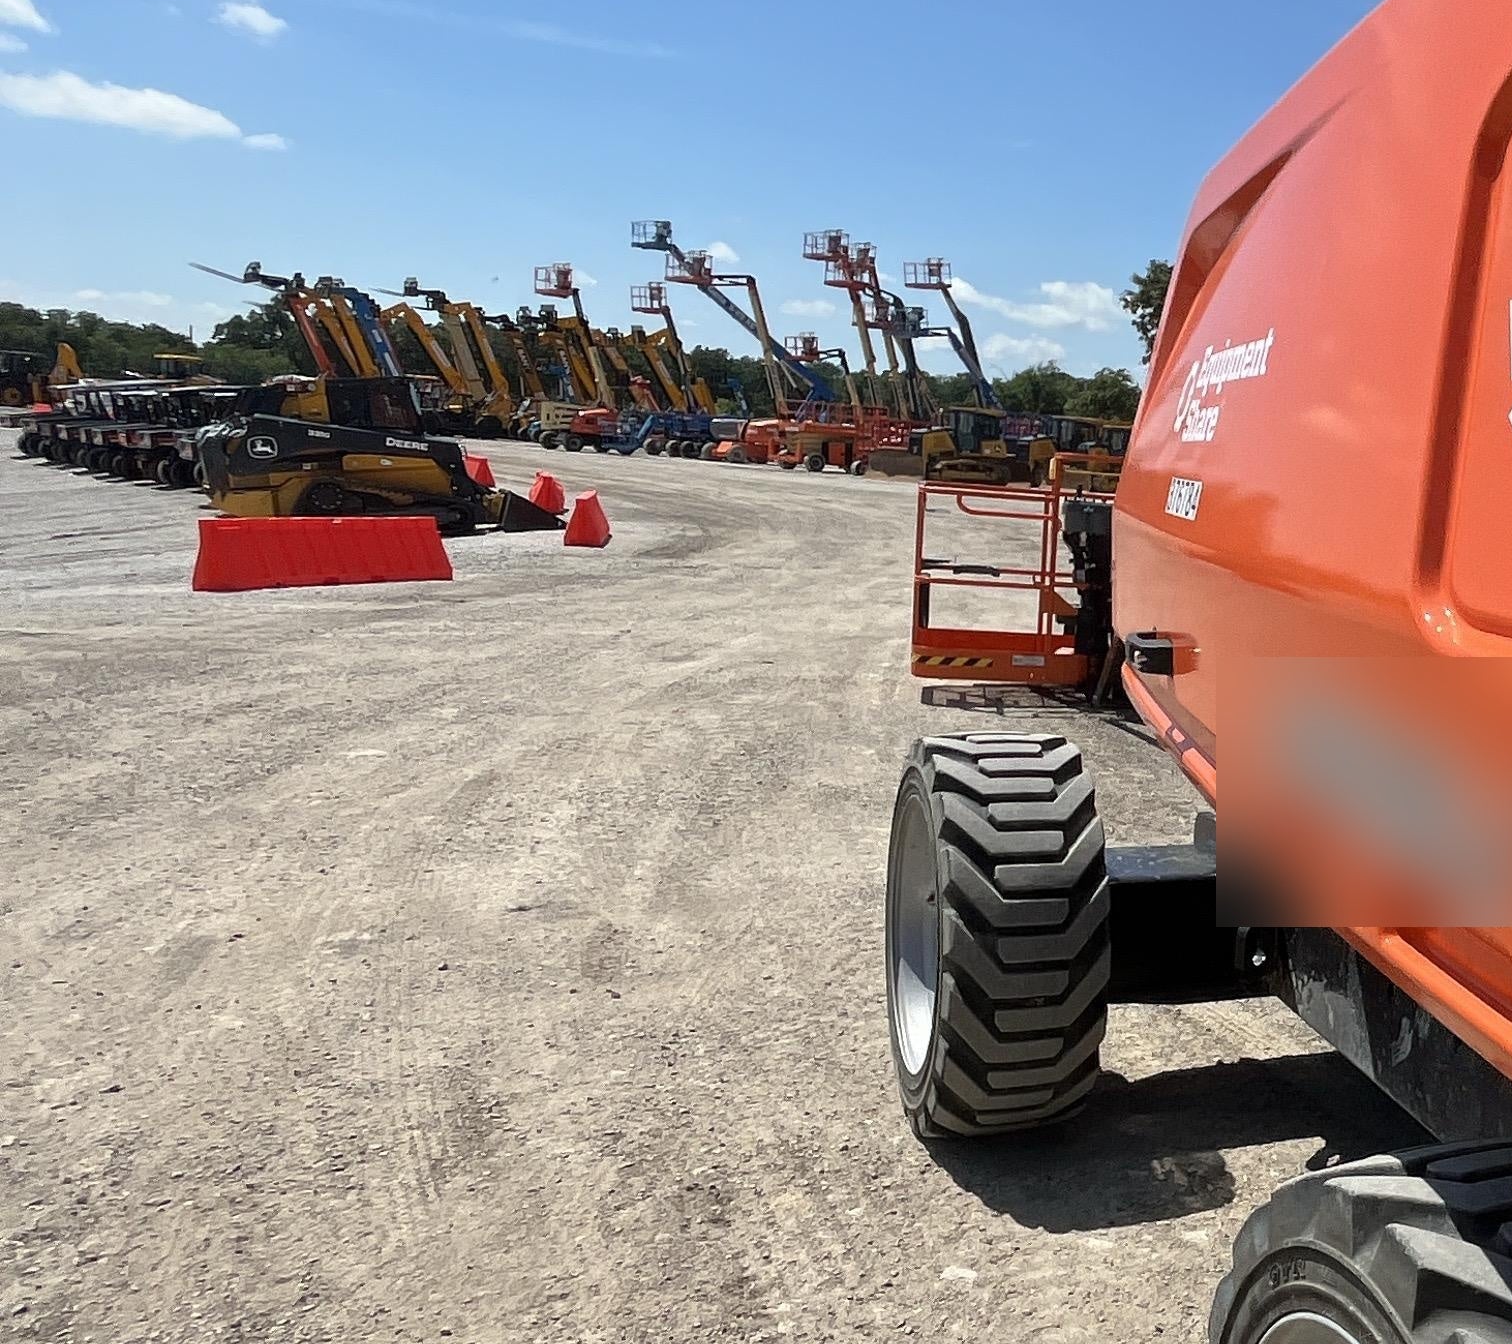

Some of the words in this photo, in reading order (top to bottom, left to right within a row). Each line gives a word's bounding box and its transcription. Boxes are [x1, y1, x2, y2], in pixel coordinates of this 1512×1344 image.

[1196, 327, 1275, 397] Equipment
[1181, 399, 1220, 443] Share
[385, 437, 429, 452] DEERE
